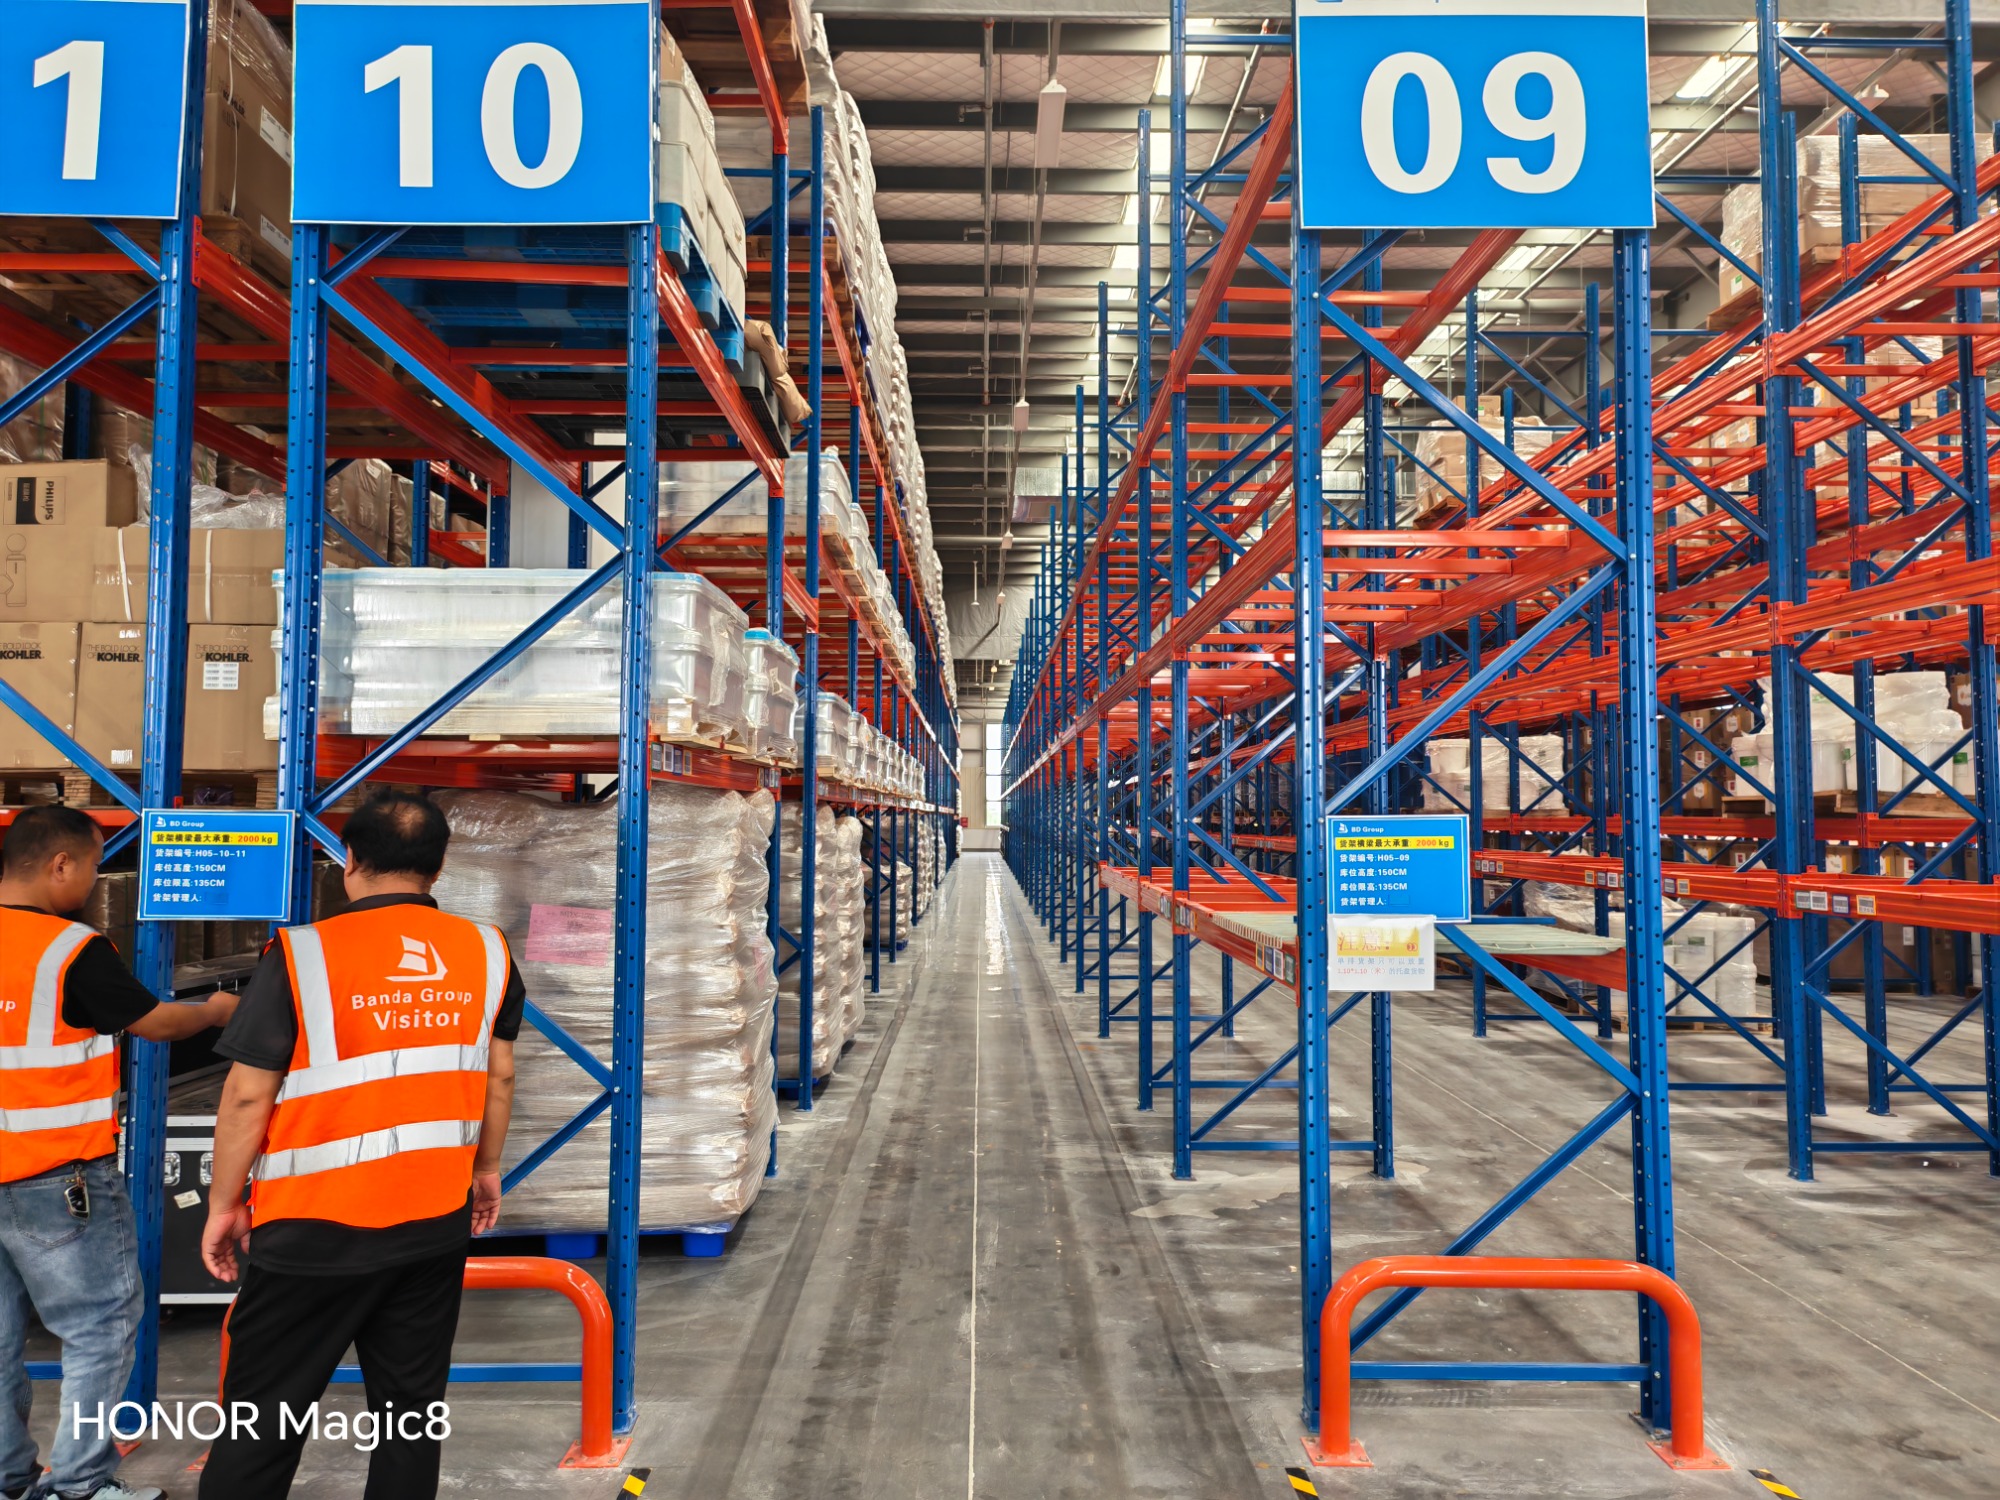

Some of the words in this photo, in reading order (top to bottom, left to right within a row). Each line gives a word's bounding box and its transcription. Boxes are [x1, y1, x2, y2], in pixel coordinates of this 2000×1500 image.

[364, 42, 583, 189] 10
[1361, 51, 1586, 194] 09
[45, 481, 54, 520] PHILIPS
[87, 644, 99, 652] THE
[101, 644, 119, 652] BOLD
[195, 644, 208, 652] THE
[209, 644, 227, 652] BOLD
[1362, 826, 1384, 834] Group
[237, 835, 260, 843] 2000
[261, 835, 273, 844] kg
[1416, 839, 1437, 847] 2000
[1438, 839, 1449, 848] kg
[152, 893, 202, 902] 货架管理人:
[1340, 897, 1387, 906] 货架管理人:
[351, 989, 413, 1010] Banda
[420, 987, 473, 1006] Group
[373, 1009, 461, 1031] Visitor
